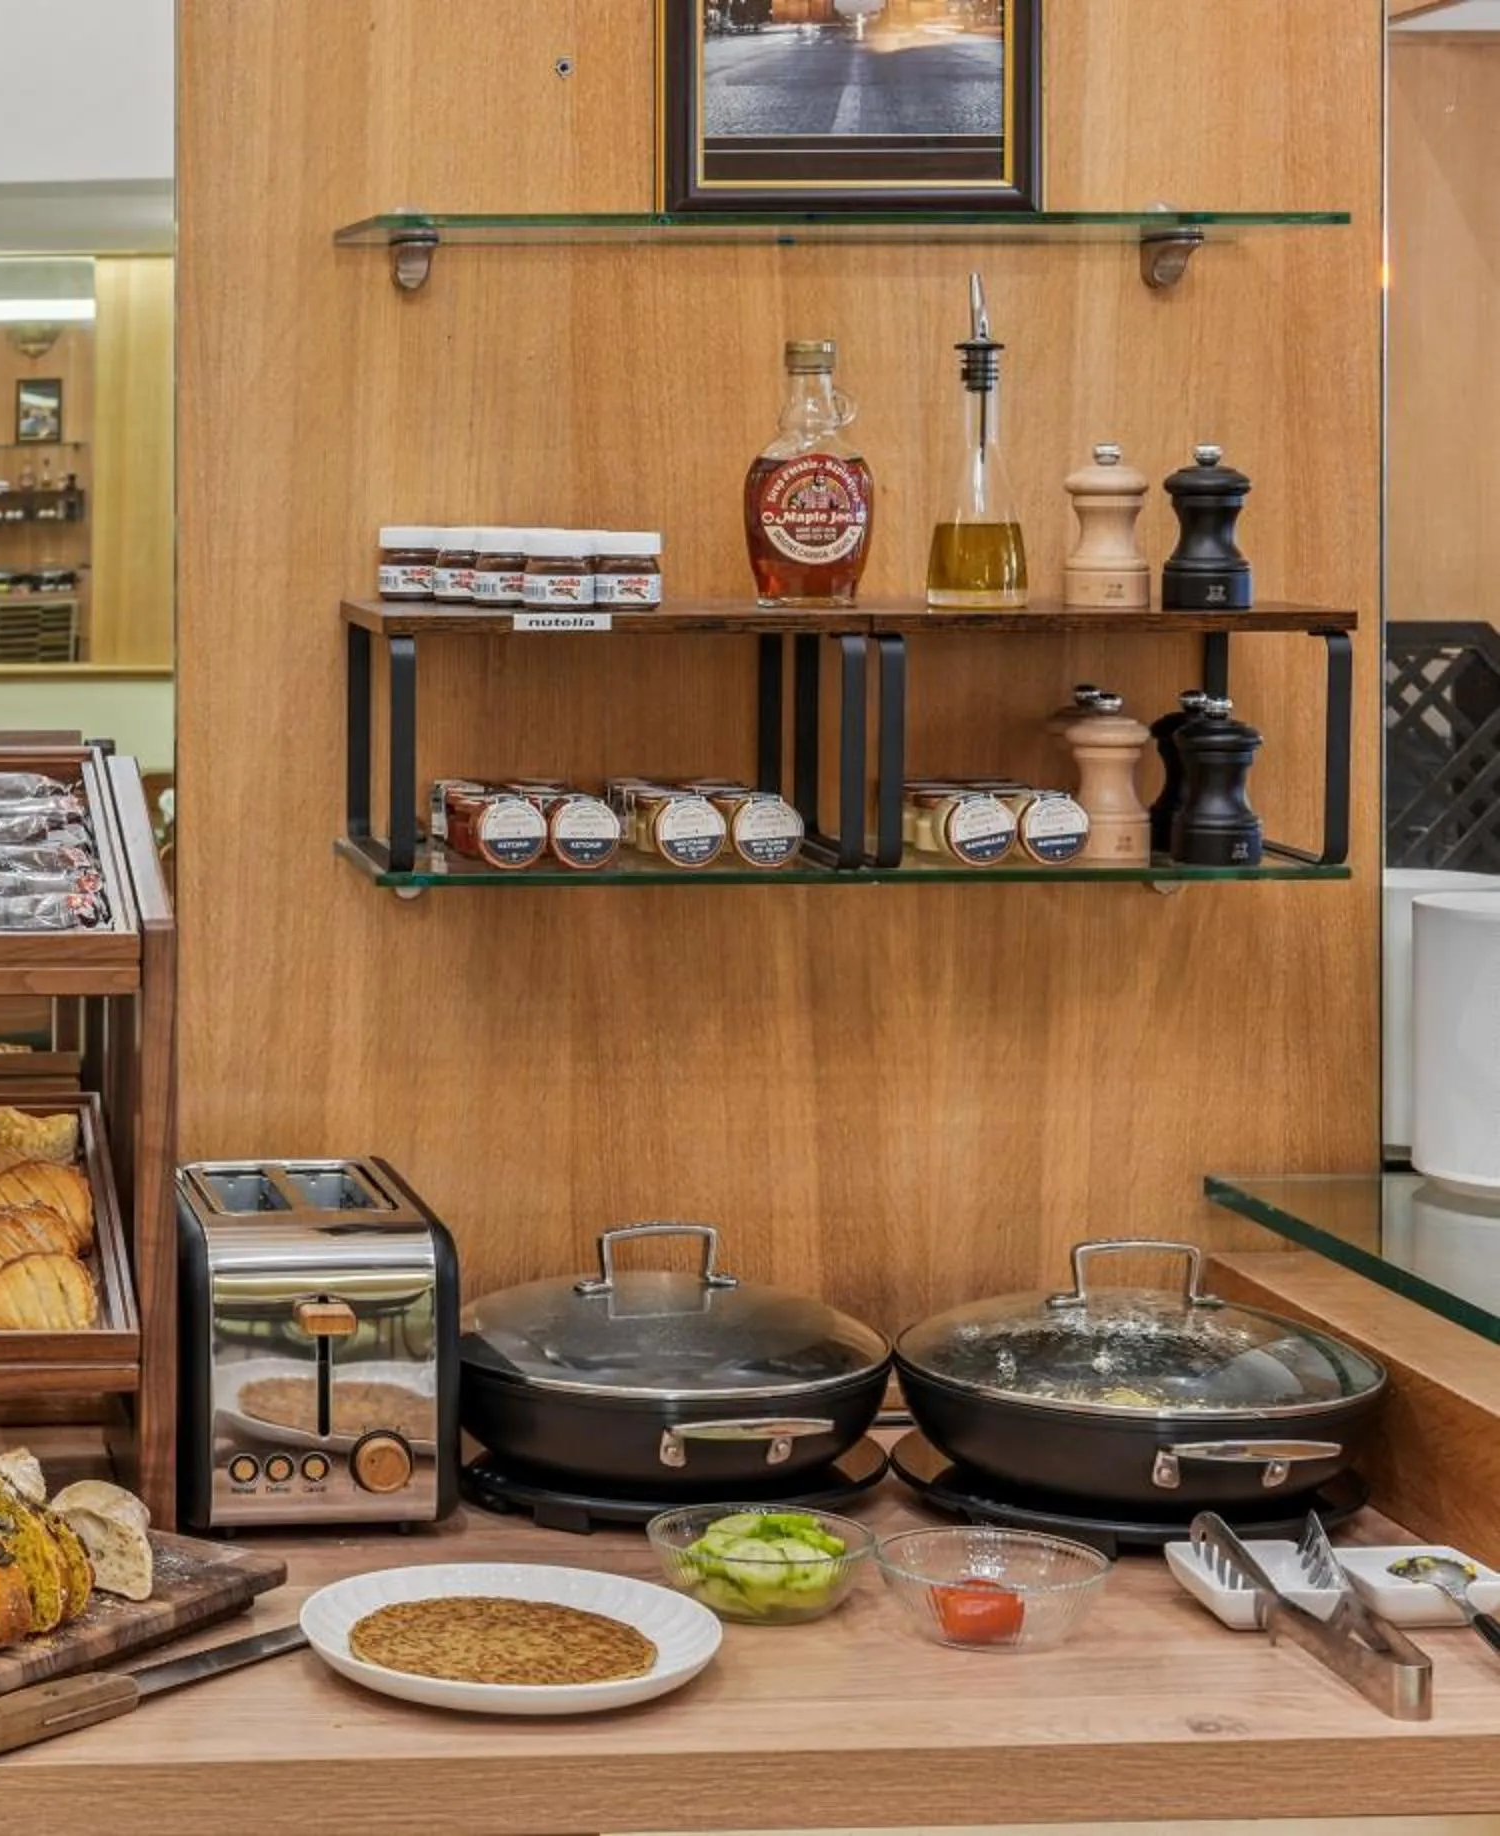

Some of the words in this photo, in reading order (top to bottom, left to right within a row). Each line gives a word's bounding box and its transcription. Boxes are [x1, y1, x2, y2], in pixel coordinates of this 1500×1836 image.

[776, 511, 828, 525] Maple
[528, 617, 595, 627] nutella
[497, 841, 530, 849] KETCHUP
[570, 841, 602, 849] KETCHUP
